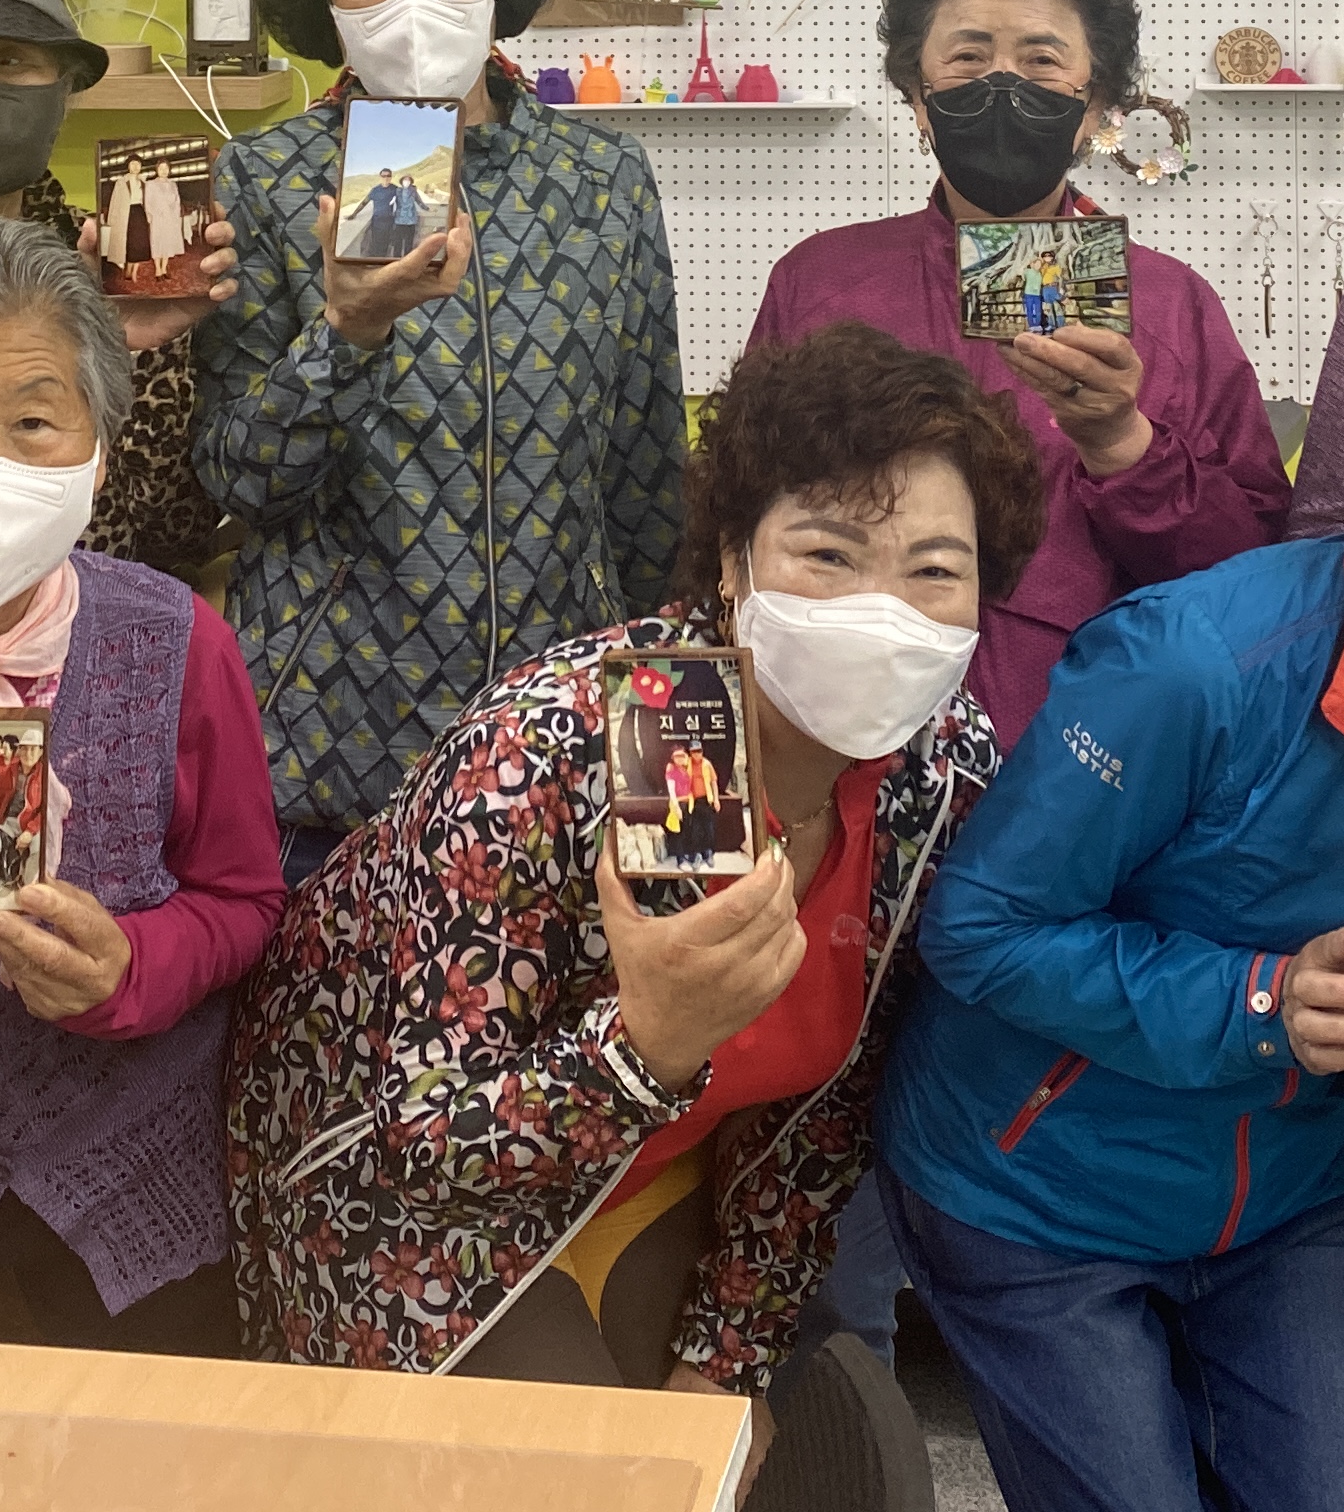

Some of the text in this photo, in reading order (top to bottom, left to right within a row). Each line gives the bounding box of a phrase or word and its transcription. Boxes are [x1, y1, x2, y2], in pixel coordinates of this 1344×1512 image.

[1218, 28, 1278, 55] STARBUCKS
[1226, 69, 1272, 84] COFFEE
[1062, 727, 1124, 792] CASTEL
[1072, 721, 1124, 772] LOUIS
